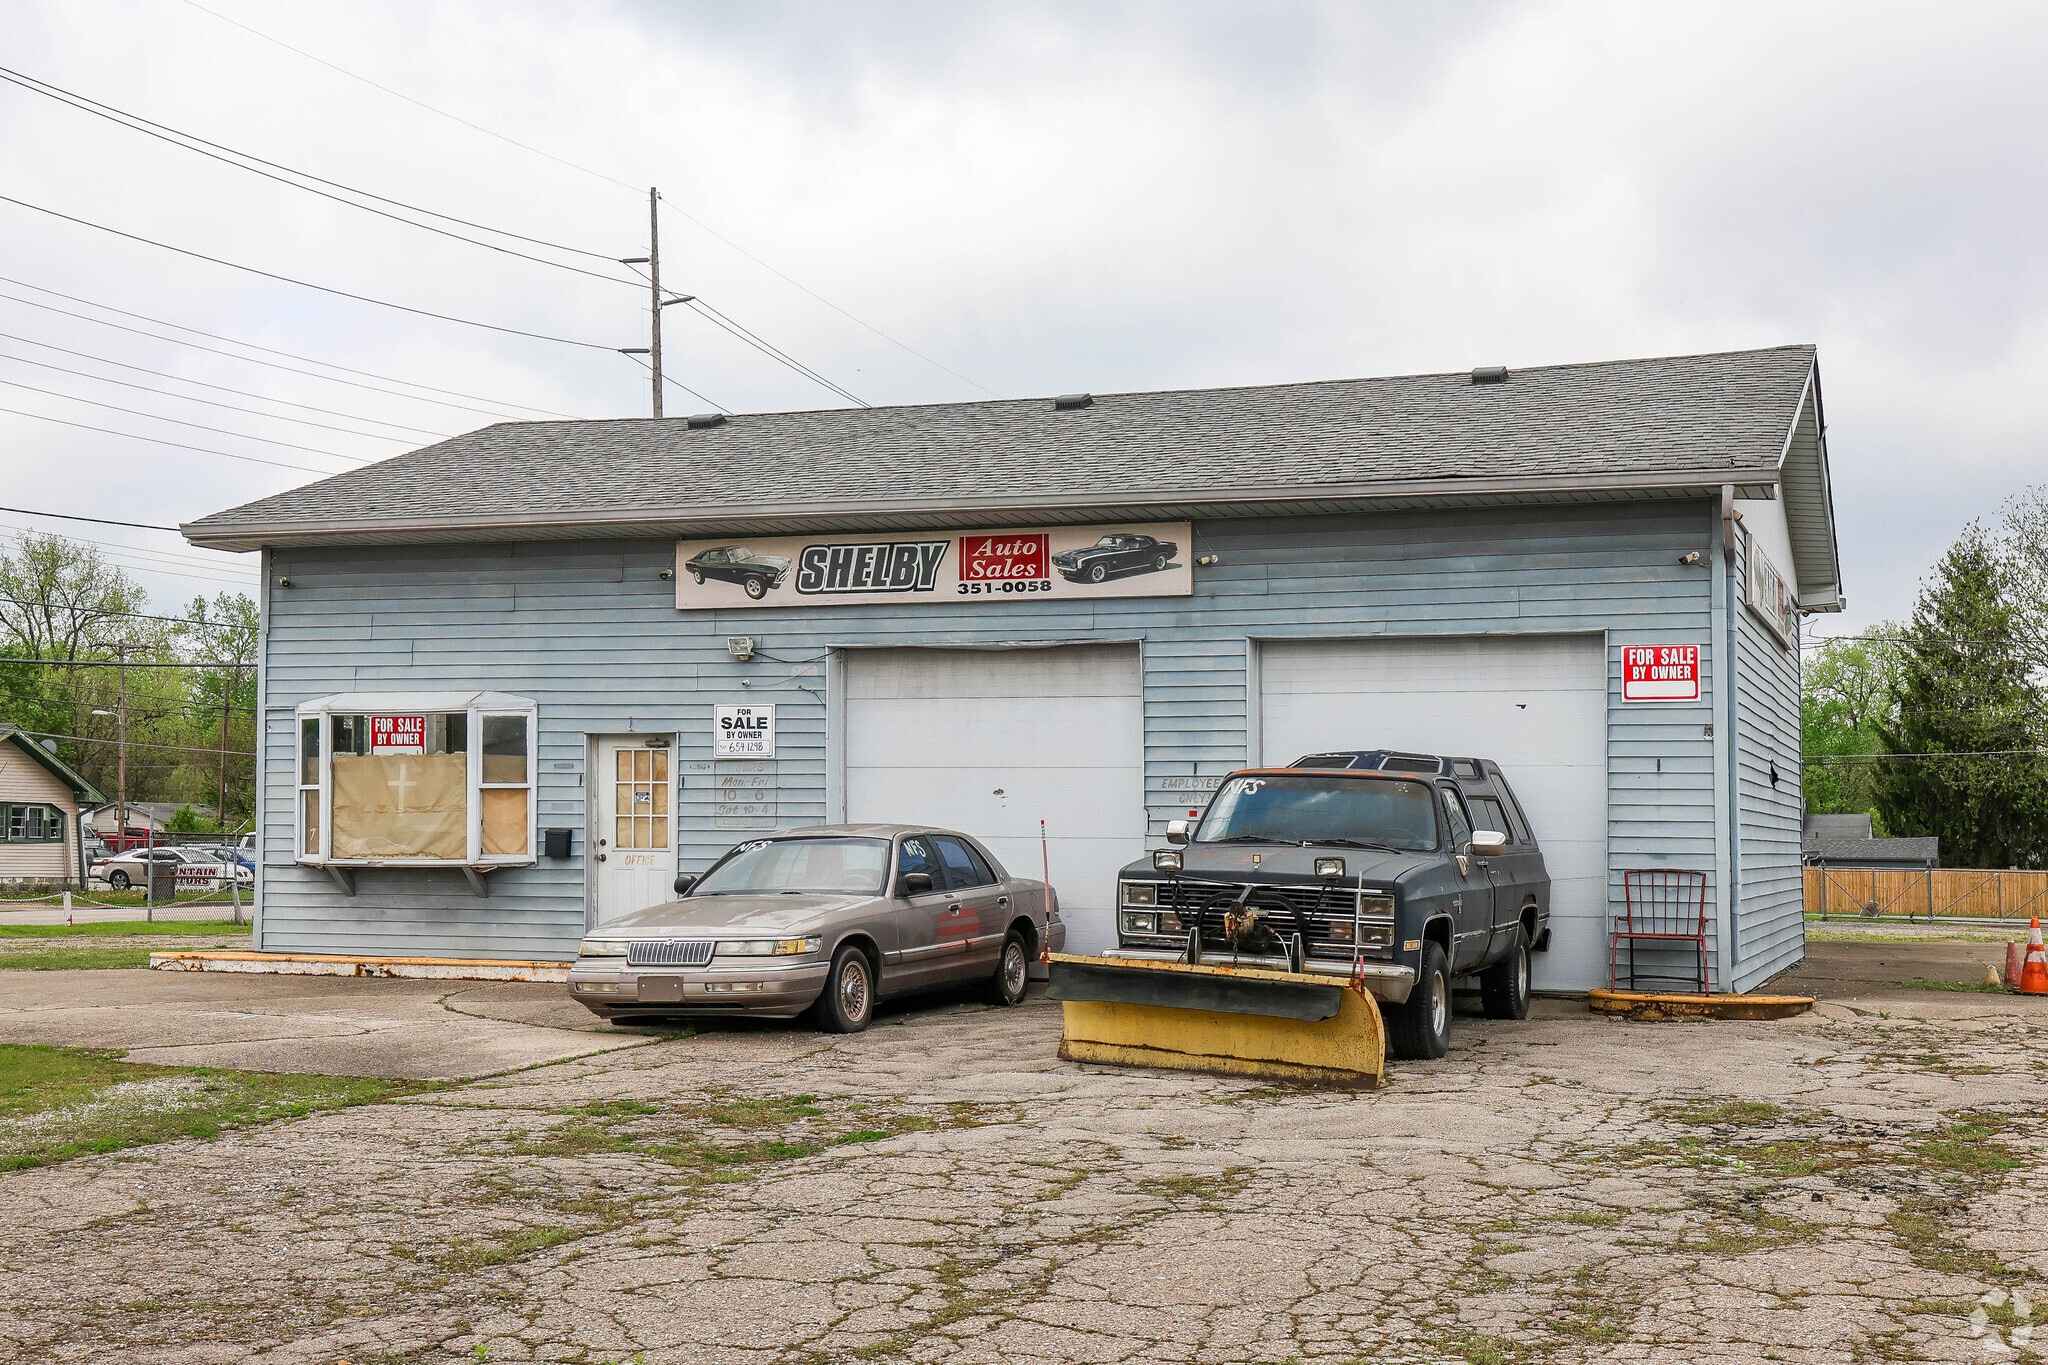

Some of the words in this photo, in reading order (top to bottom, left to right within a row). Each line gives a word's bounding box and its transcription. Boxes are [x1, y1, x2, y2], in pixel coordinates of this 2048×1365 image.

[973, 538, 1037, 557] Auto
[796, 540, 951, 595] SHELBY
[969, 557, 1037, 579] Sales
[957, 580, 1052, 595] 351-0058
[1629, 649, 1654, 665] FOR
[1660, 648, 1695, 665] SALE
[1632, 666, 1646, 679] BY
[1651, 666, 1691, 679] OWNER
[375, 718, 393, 732] FOR
[398, 718, 422, 732] SALE
[721, 717, 768, 729] SALE
[378, 733, 387, 744] BY
[391, 733, 419, 744] OWNER
[726, 731, 736, 739] BY
[737, 731, 763, 739] OWNER
[1162, 778, 1221, 789] EMPLOYEE
[1223, 778, 1266, 795] NFS
[723, 789, 737, 801] 10
[755, 790, 764, 801] 6
[732, 840, 773, 854] NFS
[903, 839, 926, 858] NFS
[625, 855, 655, 865] OFFICE
